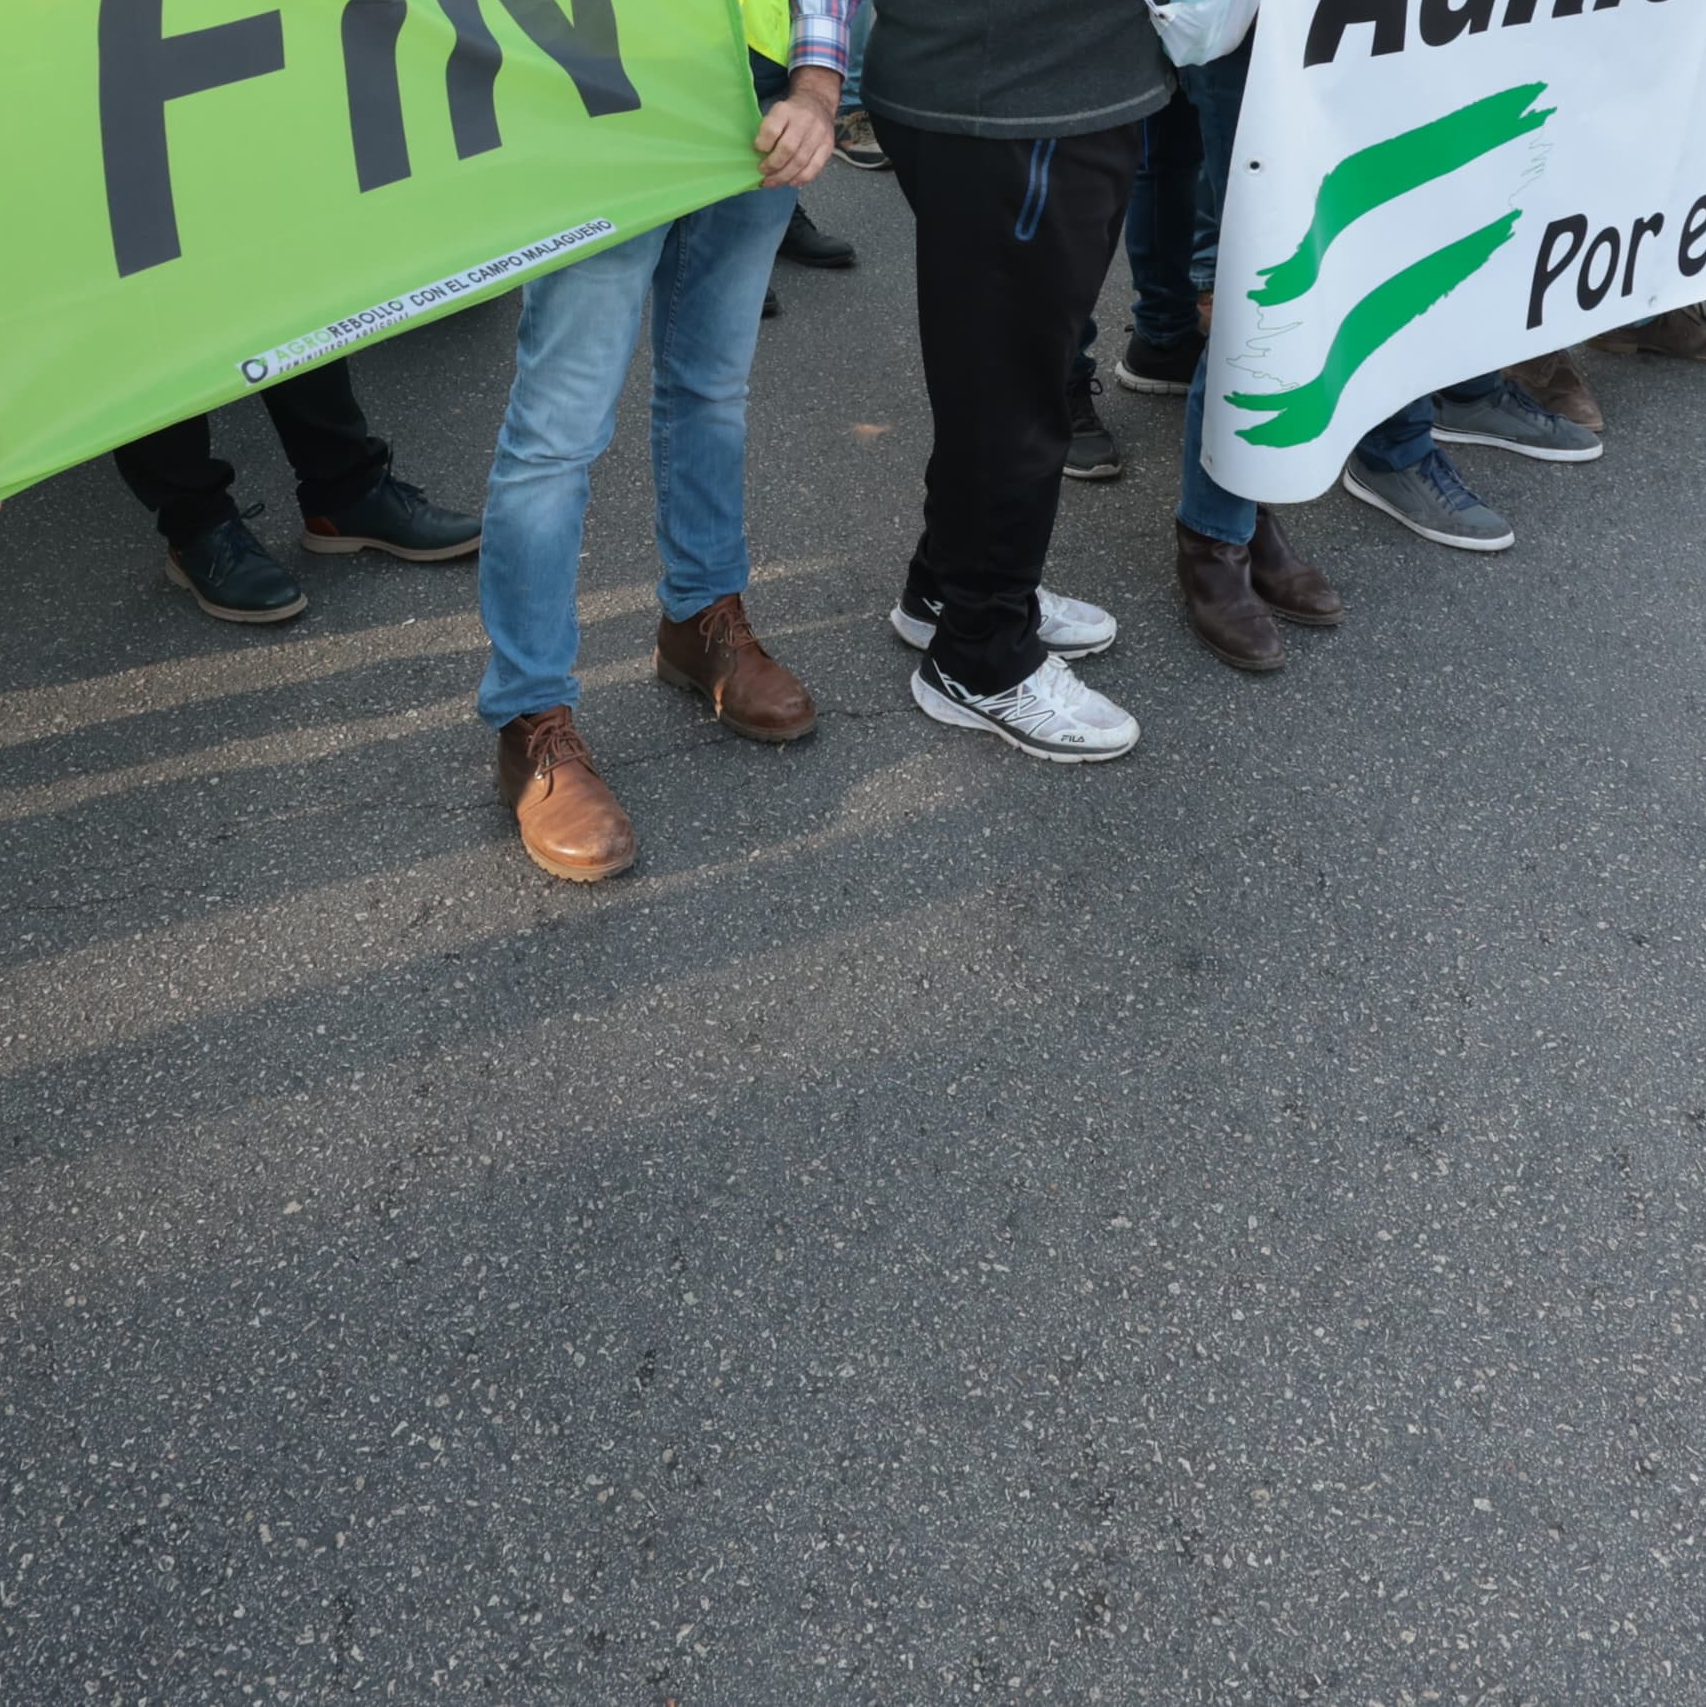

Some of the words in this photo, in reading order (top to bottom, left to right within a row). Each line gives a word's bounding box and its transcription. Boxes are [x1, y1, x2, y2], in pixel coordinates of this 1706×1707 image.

[275, 299, 405, 364] AGROREBOLLO
[410, 286, 447, 308] CON
[447, 274, 470, 294] EL
[467, 254, 524, 285] CAMPO
[521, 218, 613, 263] MALAGUEÑO
[1525, 211, 1665, 330] Por
[1060, 734, 1085, 743] FILA
